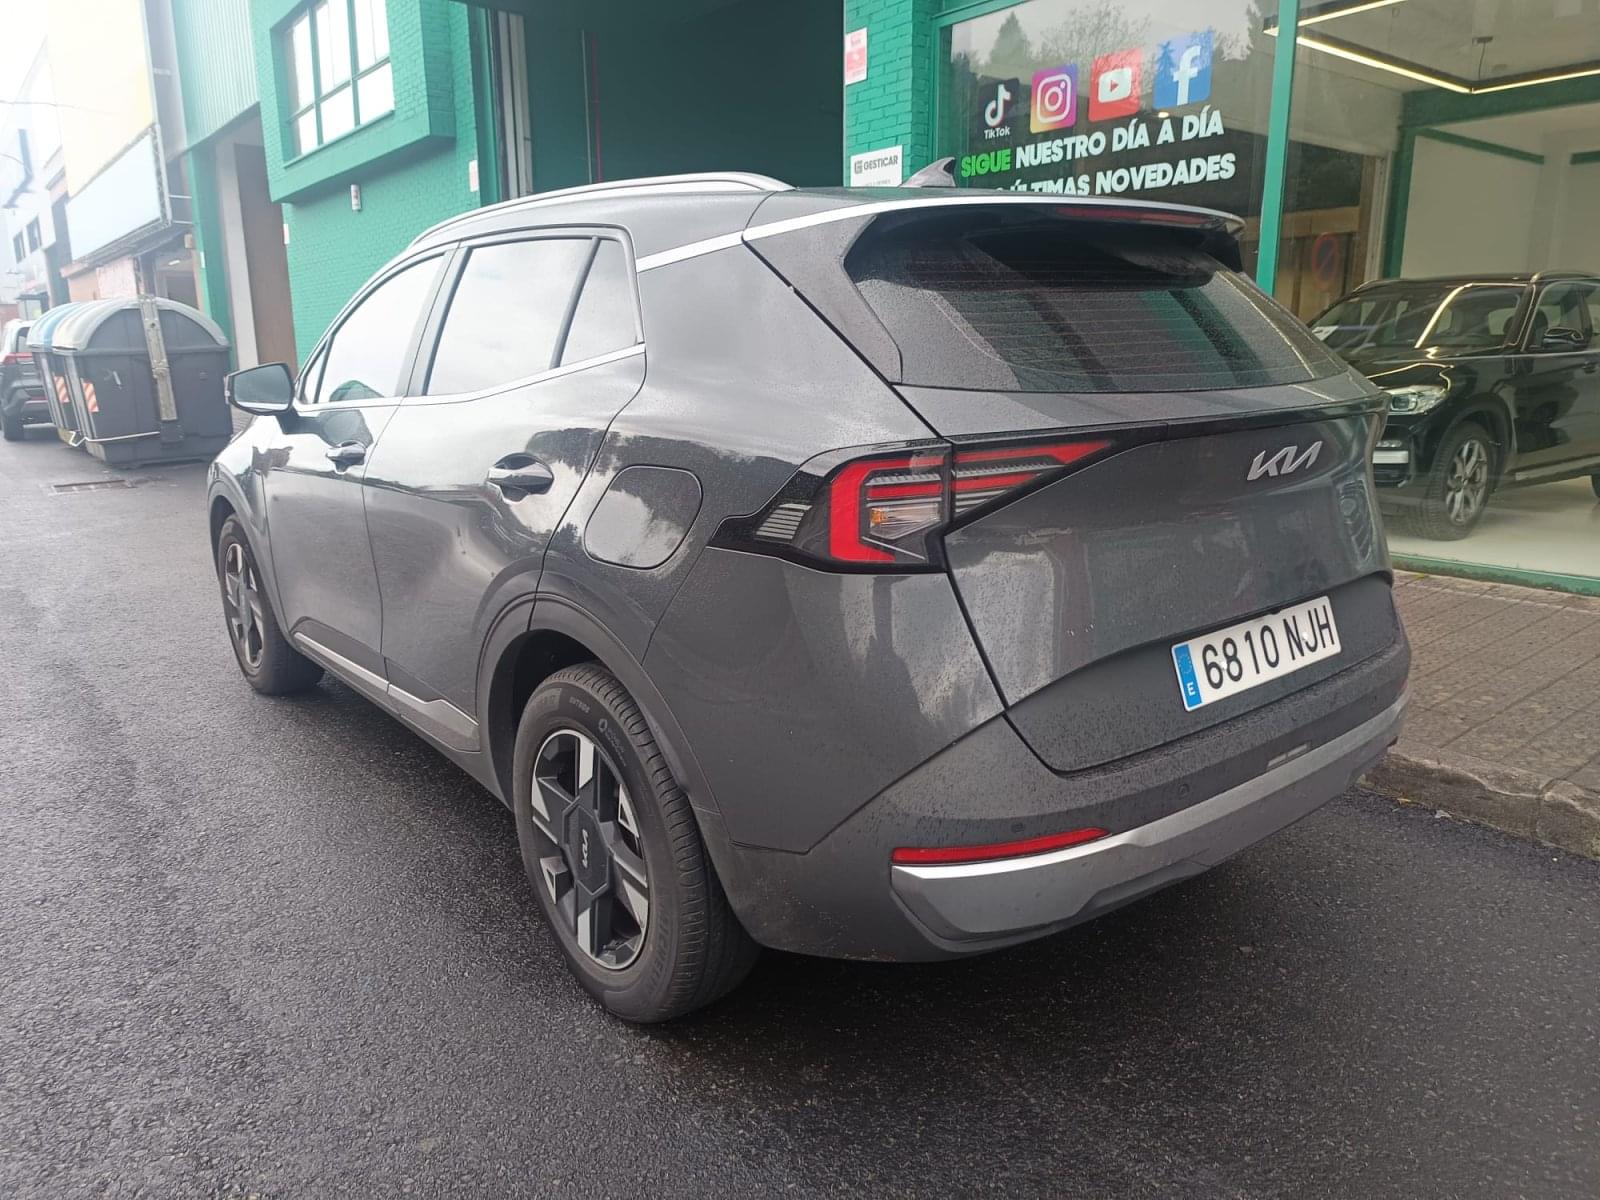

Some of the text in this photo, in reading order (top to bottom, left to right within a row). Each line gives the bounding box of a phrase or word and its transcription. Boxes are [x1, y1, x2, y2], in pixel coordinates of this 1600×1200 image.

[961, 104, 1224, 178] SIGUE NUESTRO DÍA A DÍA
[984, 126, 1011, 139] TikTok
[863, 155, 899, 171] GESTICAR
[1095, 152, 1236, 195] NOVEDADES
[1187, 605, 1335, 696] E 6810 NJH
